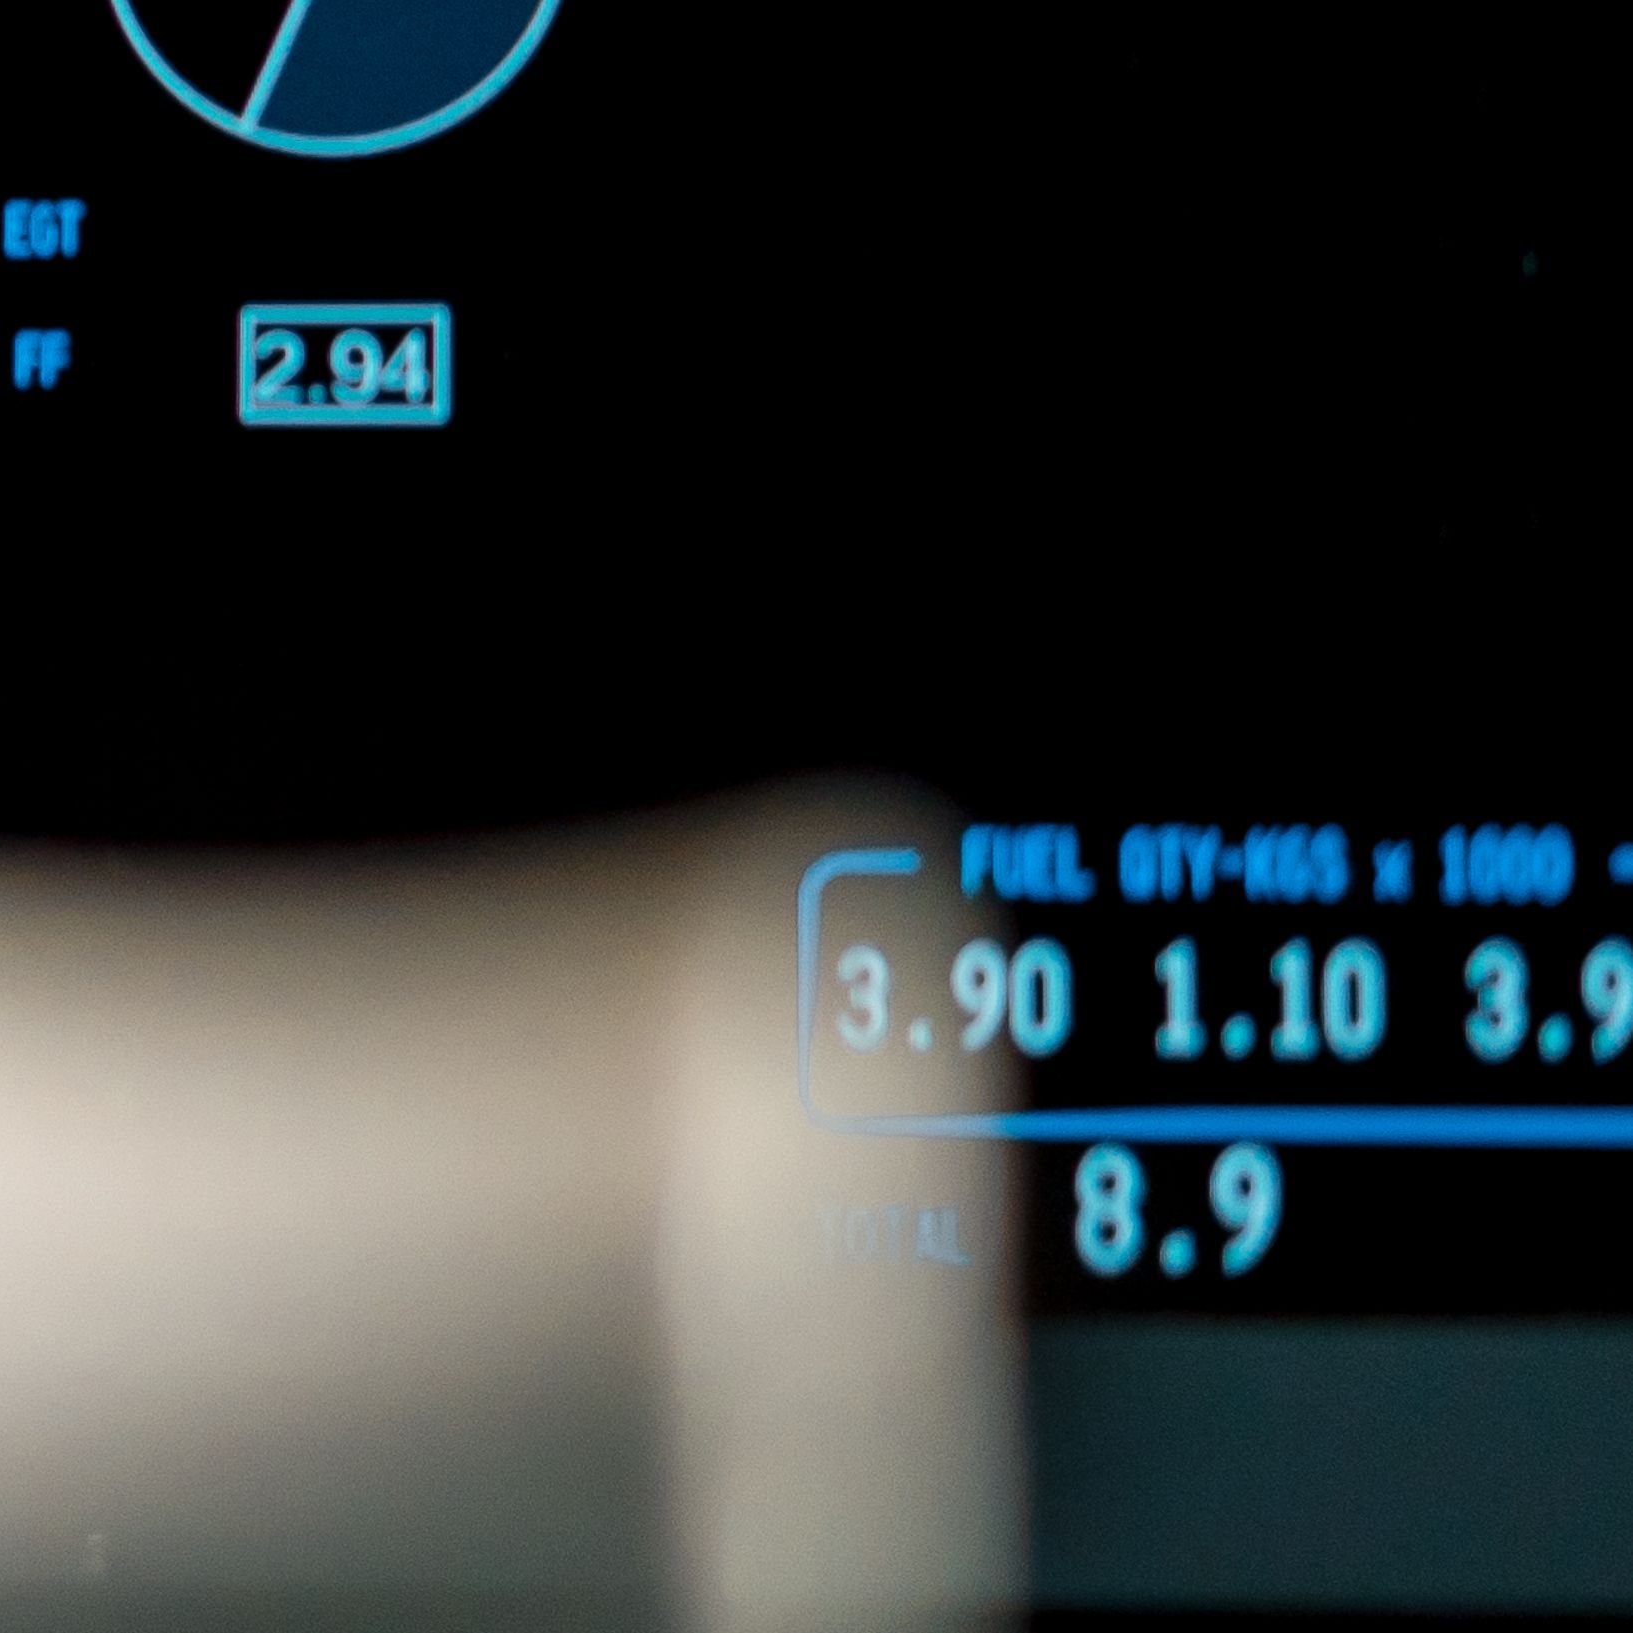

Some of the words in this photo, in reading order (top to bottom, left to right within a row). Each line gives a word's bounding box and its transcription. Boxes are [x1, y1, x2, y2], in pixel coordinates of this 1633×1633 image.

[2, 198, 86, 259] EGT
[13, 329, 70, 389] FF
[253, 329, 430, 406] 2.94
[960, 824, 1093, 901] FUEL
[1441, 825, 1575, 903] 1000
[836, 938, 1073, 1056] 3.90
[1155, 938, 1386, 1059] 1.10
[1075, 1142, 1282, 1276] 8.9
